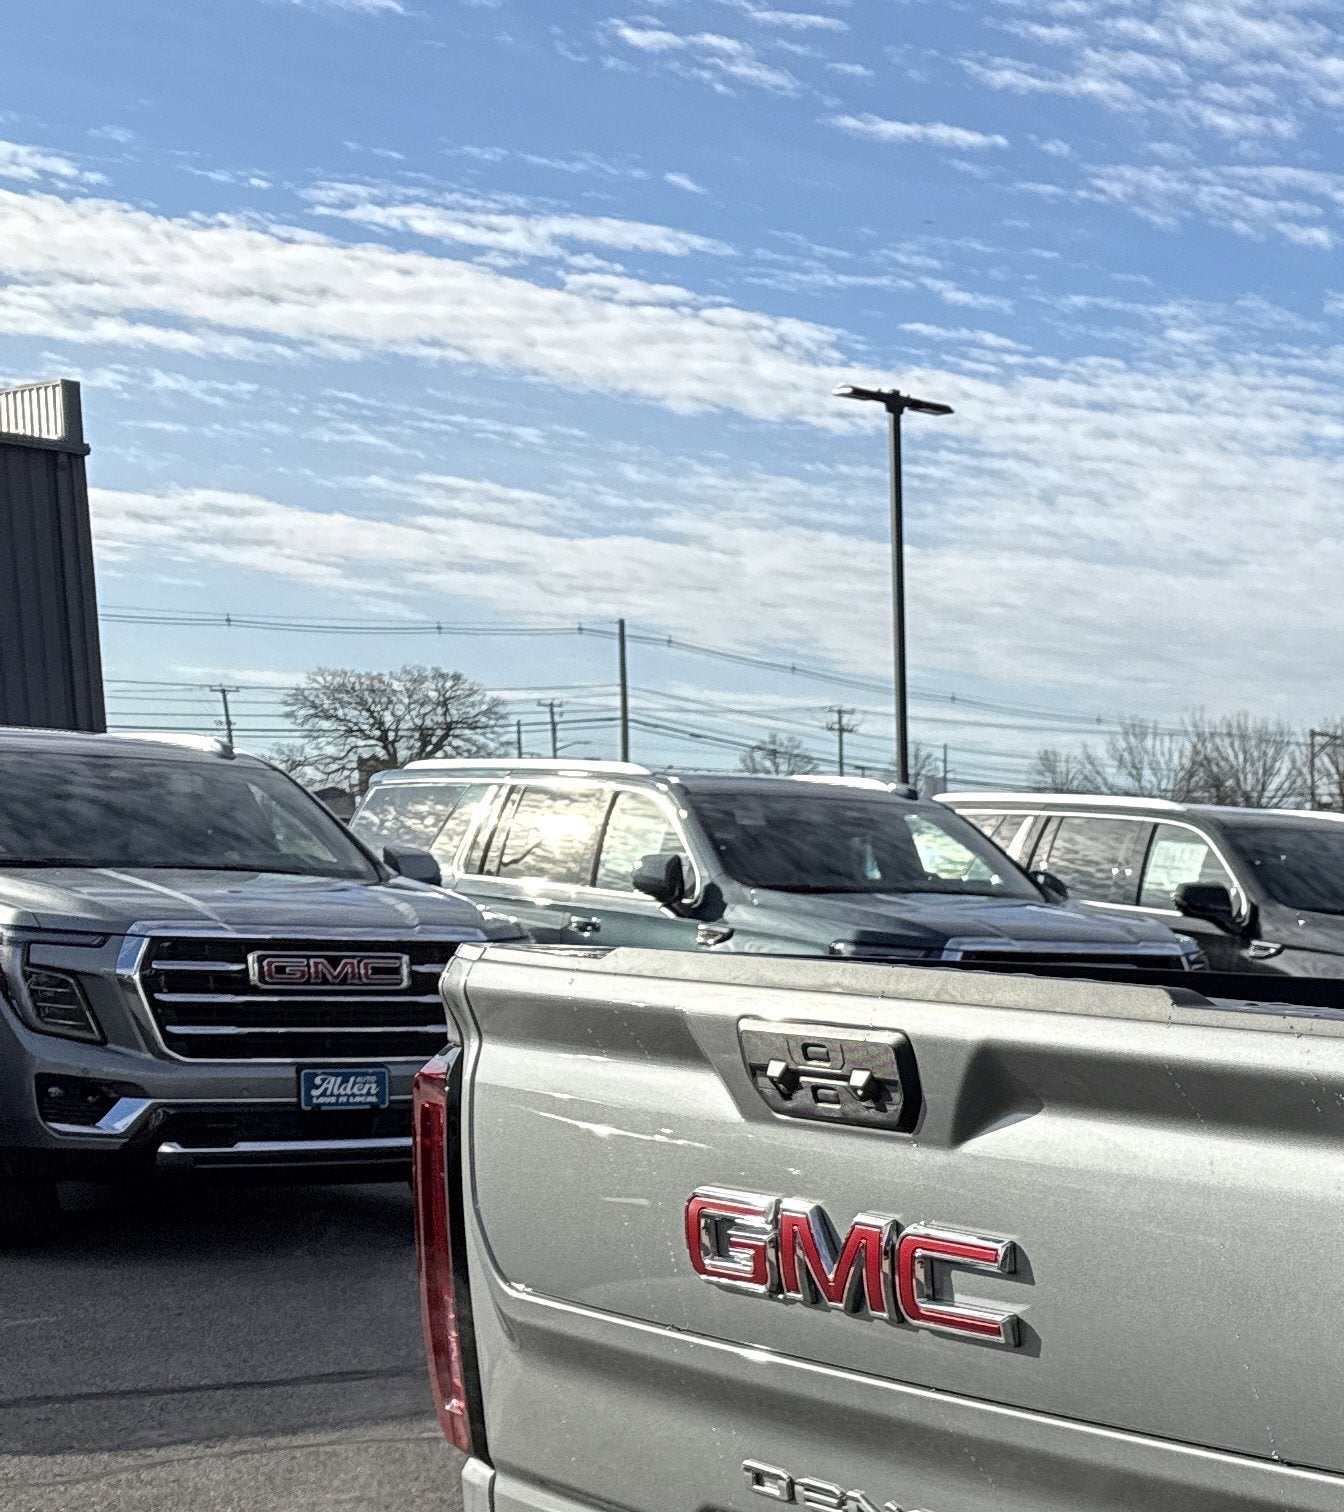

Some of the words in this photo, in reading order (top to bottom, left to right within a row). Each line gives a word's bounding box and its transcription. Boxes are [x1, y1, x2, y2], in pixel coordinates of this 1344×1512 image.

[263, 957, 402, 984] GMC
[310, 1074, 379, 1097] Alden
[685, 1184, 1021, 1347] GMC
